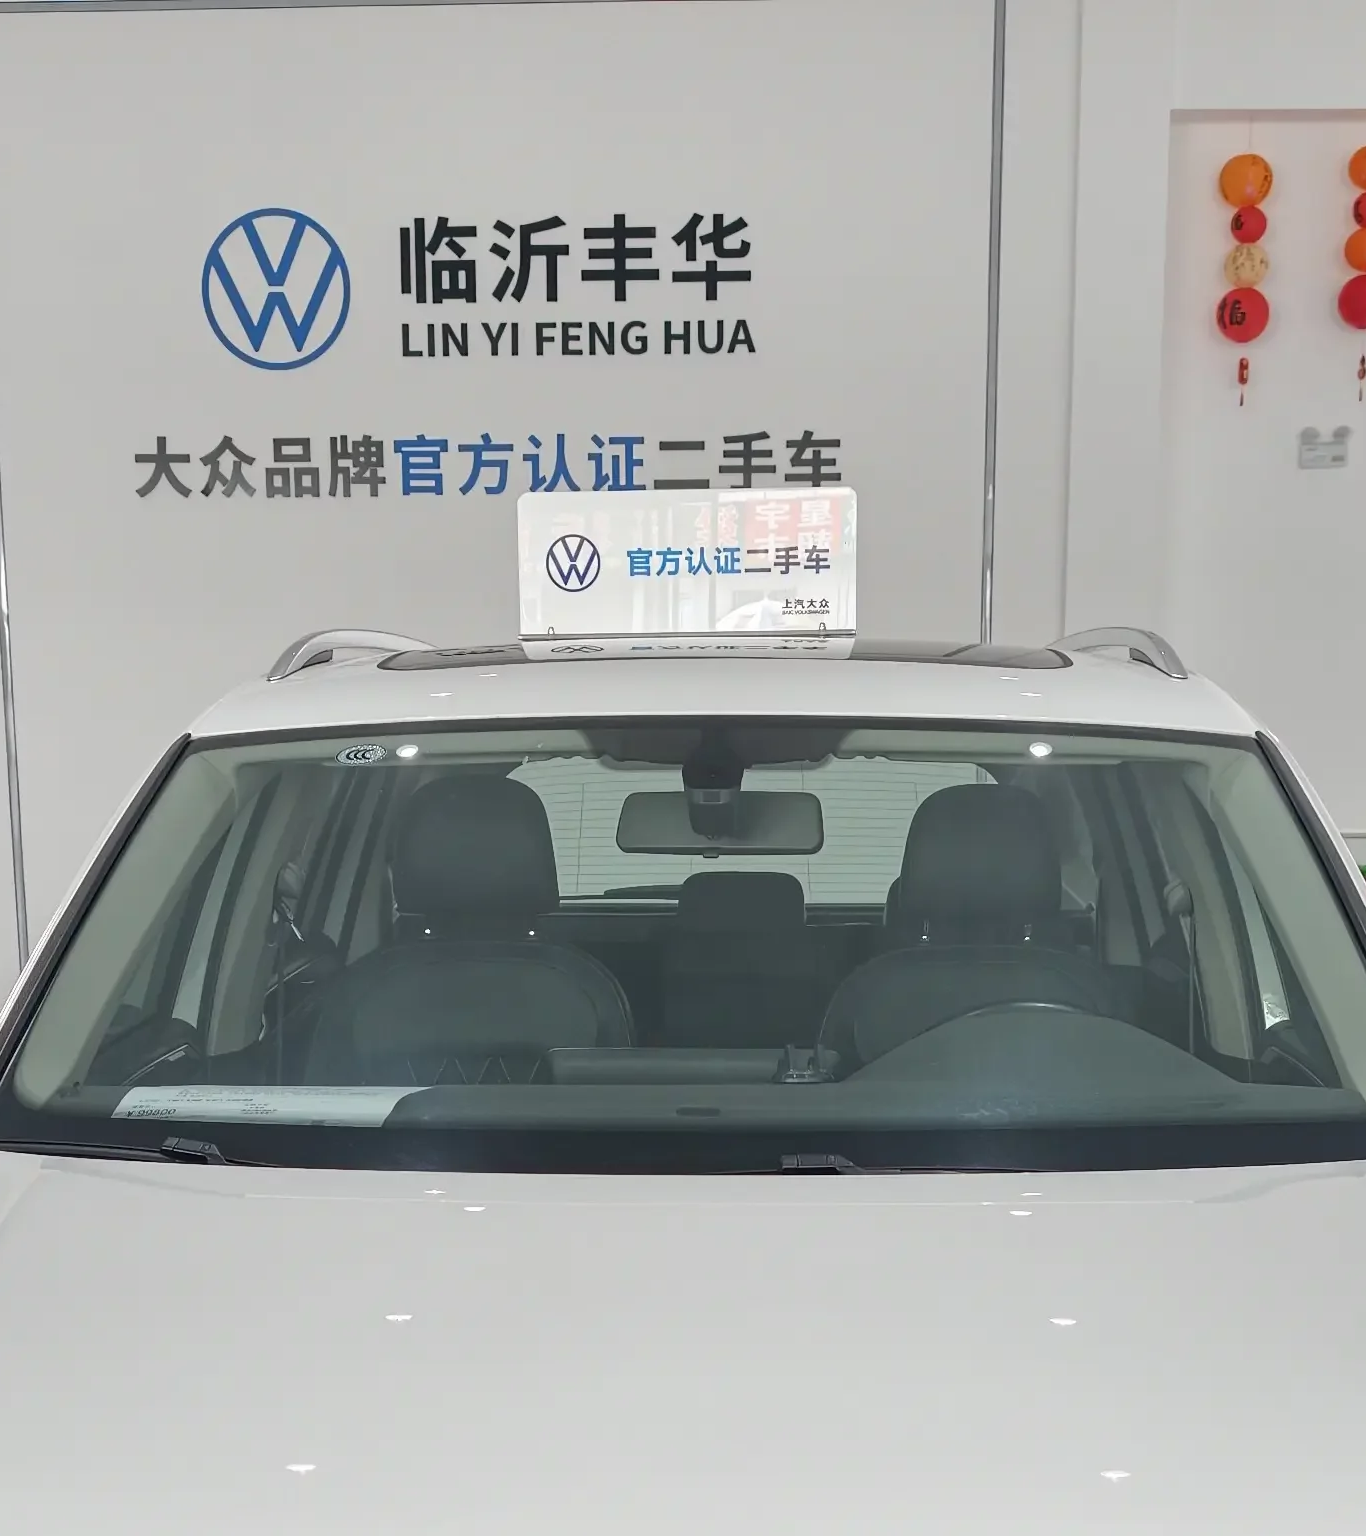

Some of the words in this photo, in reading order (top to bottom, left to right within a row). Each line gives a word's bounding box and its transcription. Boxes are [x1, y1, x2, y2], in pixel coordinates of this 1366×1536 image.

[399, 213, 752, 304] 临沂丰华
[401, 323, 469, 357] LIN
[481, 322, 519, 356] YI
[535, 320, 649, 356] FENG
[663, 319, 756, 354] HUA
[134, 430, 842, 499] 大众品牌官方认证二手车
[626, 546, 831, 577] 官方认证二手车
[782, 598, 830, 609] 上汽大众
